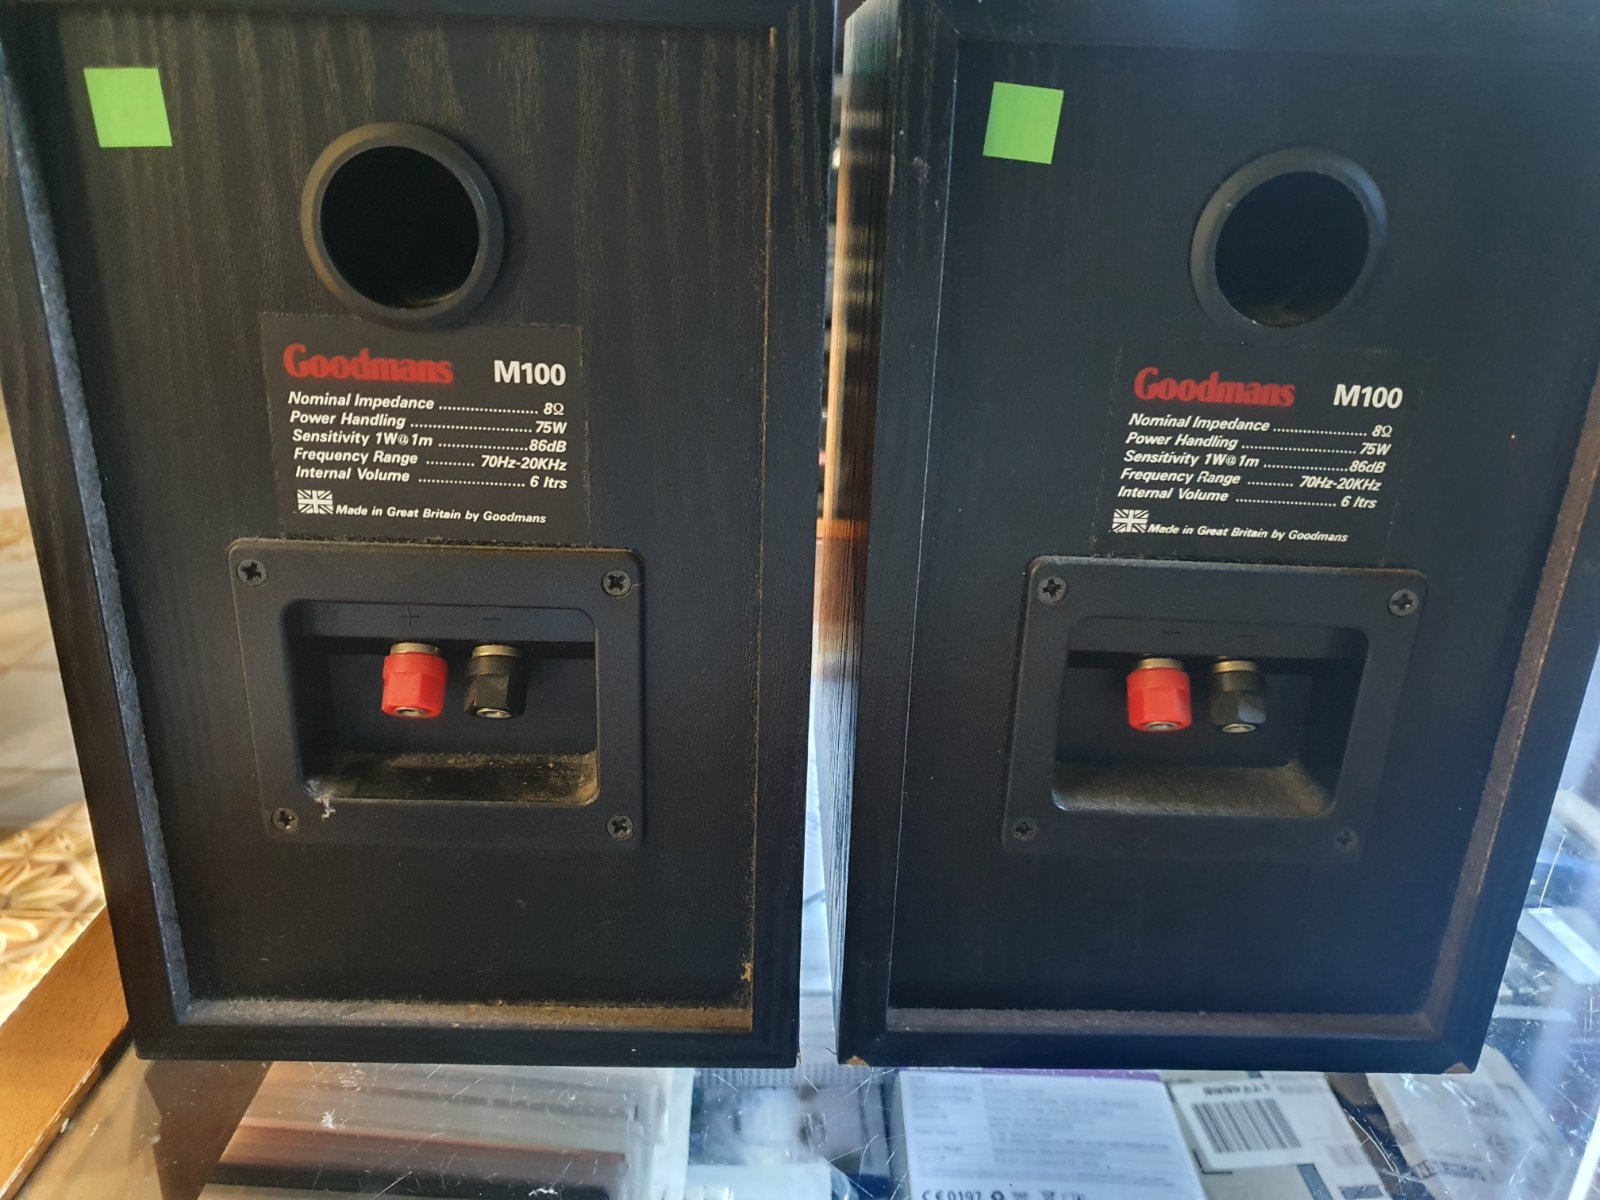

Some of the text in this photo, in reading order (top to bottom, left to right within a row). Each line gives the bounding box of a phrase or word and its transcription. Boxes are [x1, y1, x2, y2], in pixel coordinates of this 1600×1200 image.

[283, 344, 453, 384] Goodmans
[494, 360, 566, 386] M100
[1134, 367, 1296, 408] Goodmans
[1333, 384, 1403, 409] M100
[288, 392, 350, 406] Nominal
[354, 394, 434, 412] Impedance
[290, 411, 567, 434] Power Handling 75W
[1128, 413, 1189, 428] Nominal
[1192, 416, 1270, 432] Impedance
[292, 429, 369, 447] Sensitivity
[1125, 432, 1391, 455] Power Handling 75W
[294, 448, 368, 465] Frequency
[373, 451, 418, 466] Range
[1124, 450, 1199, 466] Sensitivity
[296, 466, 351, 479] Internal
[357, 468, 410, 482] Volume
[529, 476, 539, 488] 6
[1120, 468, 1193, 484] Frequency
[1197, 471, 1241, 486] Range
[1117, 486, 1172, 499] Internal
[1178, 488, 1228, 502] Volume
[1340, 495, 1350, 508] 6
[336, 505, 547, 523] Made in Great Britain by Goodmans
[1147, 524, 1348, 542] Made in Great Britain by Goodmans
